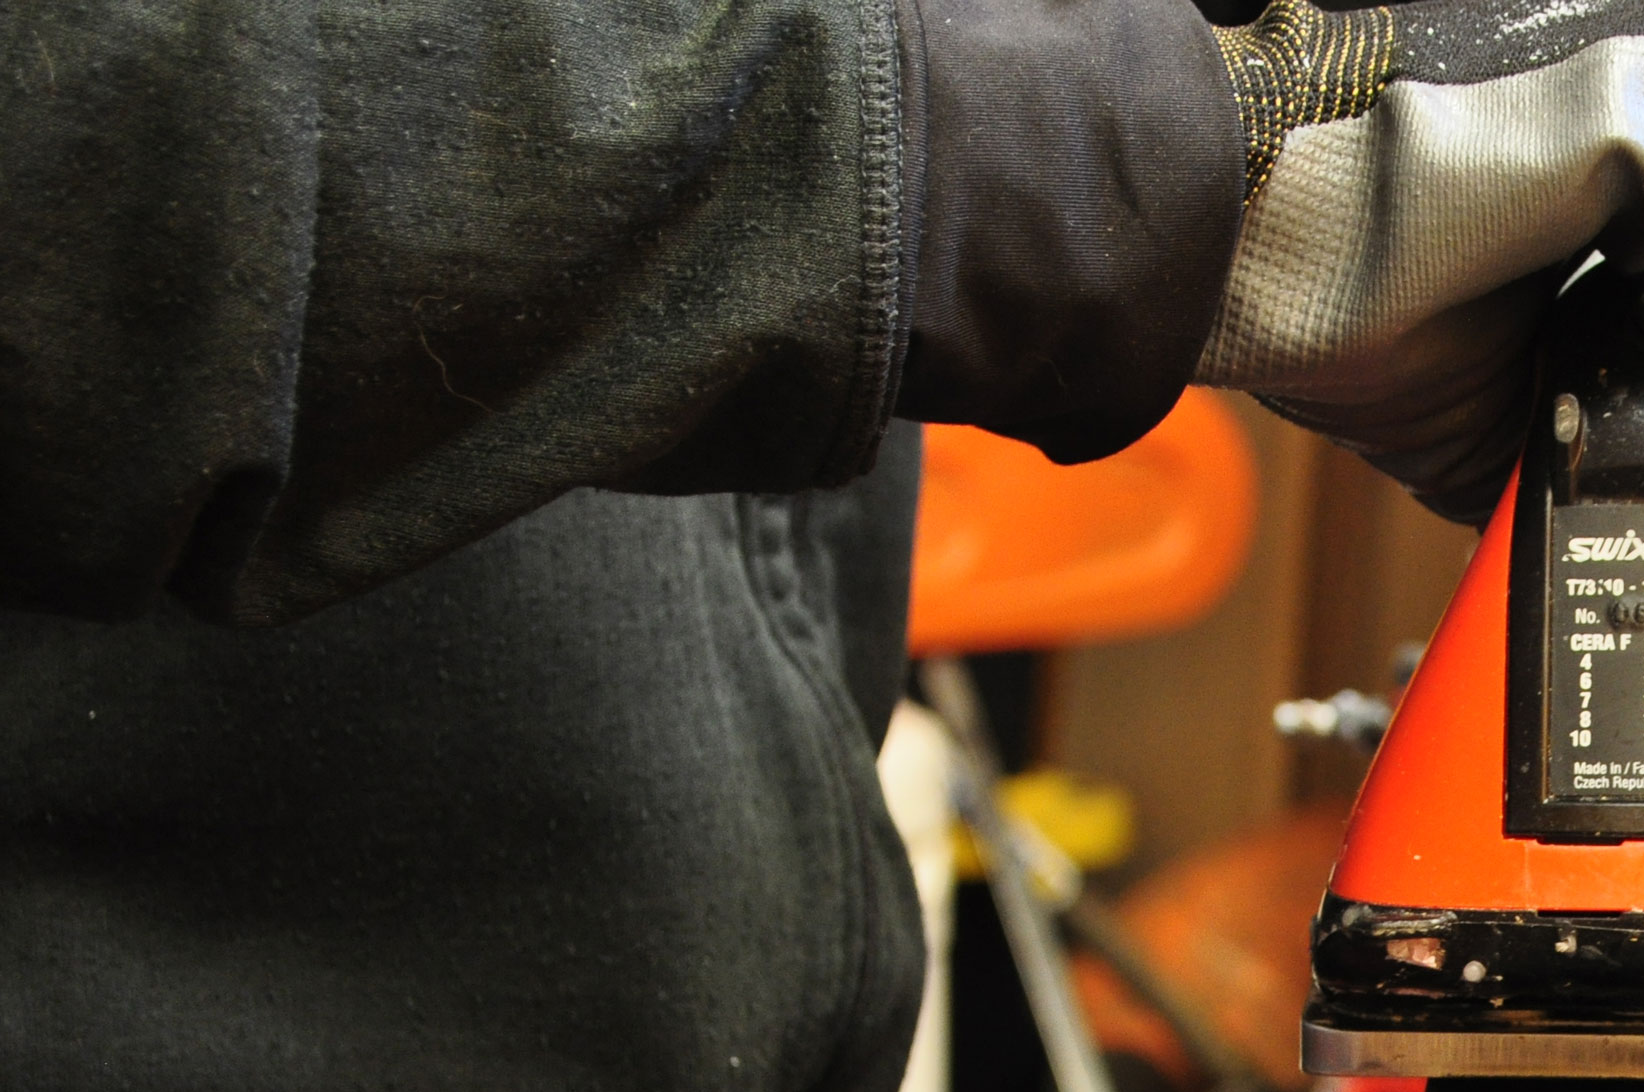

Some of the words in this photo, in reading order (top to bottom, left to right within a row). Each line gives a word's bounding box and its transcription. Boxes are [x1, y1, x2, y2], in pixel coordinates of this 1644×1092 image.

[1575, 608, 1600, 624] No.
[1570, 634, 1615, 651] CERA
[1620, 634, 1631, 650] F
[1579, 653, 1592, 670] 4
[1579, 672, 1592, 690] 6
[1579, 692, 1591, 709] 7
[1579, 711, 1591, 728] 8
[1569, 730, 1592, 747] 10
[1574, 762, 1608, 775] Made
[1610, 762, 1622, 775] in
[1574, 776, 1610, 790] Czech
